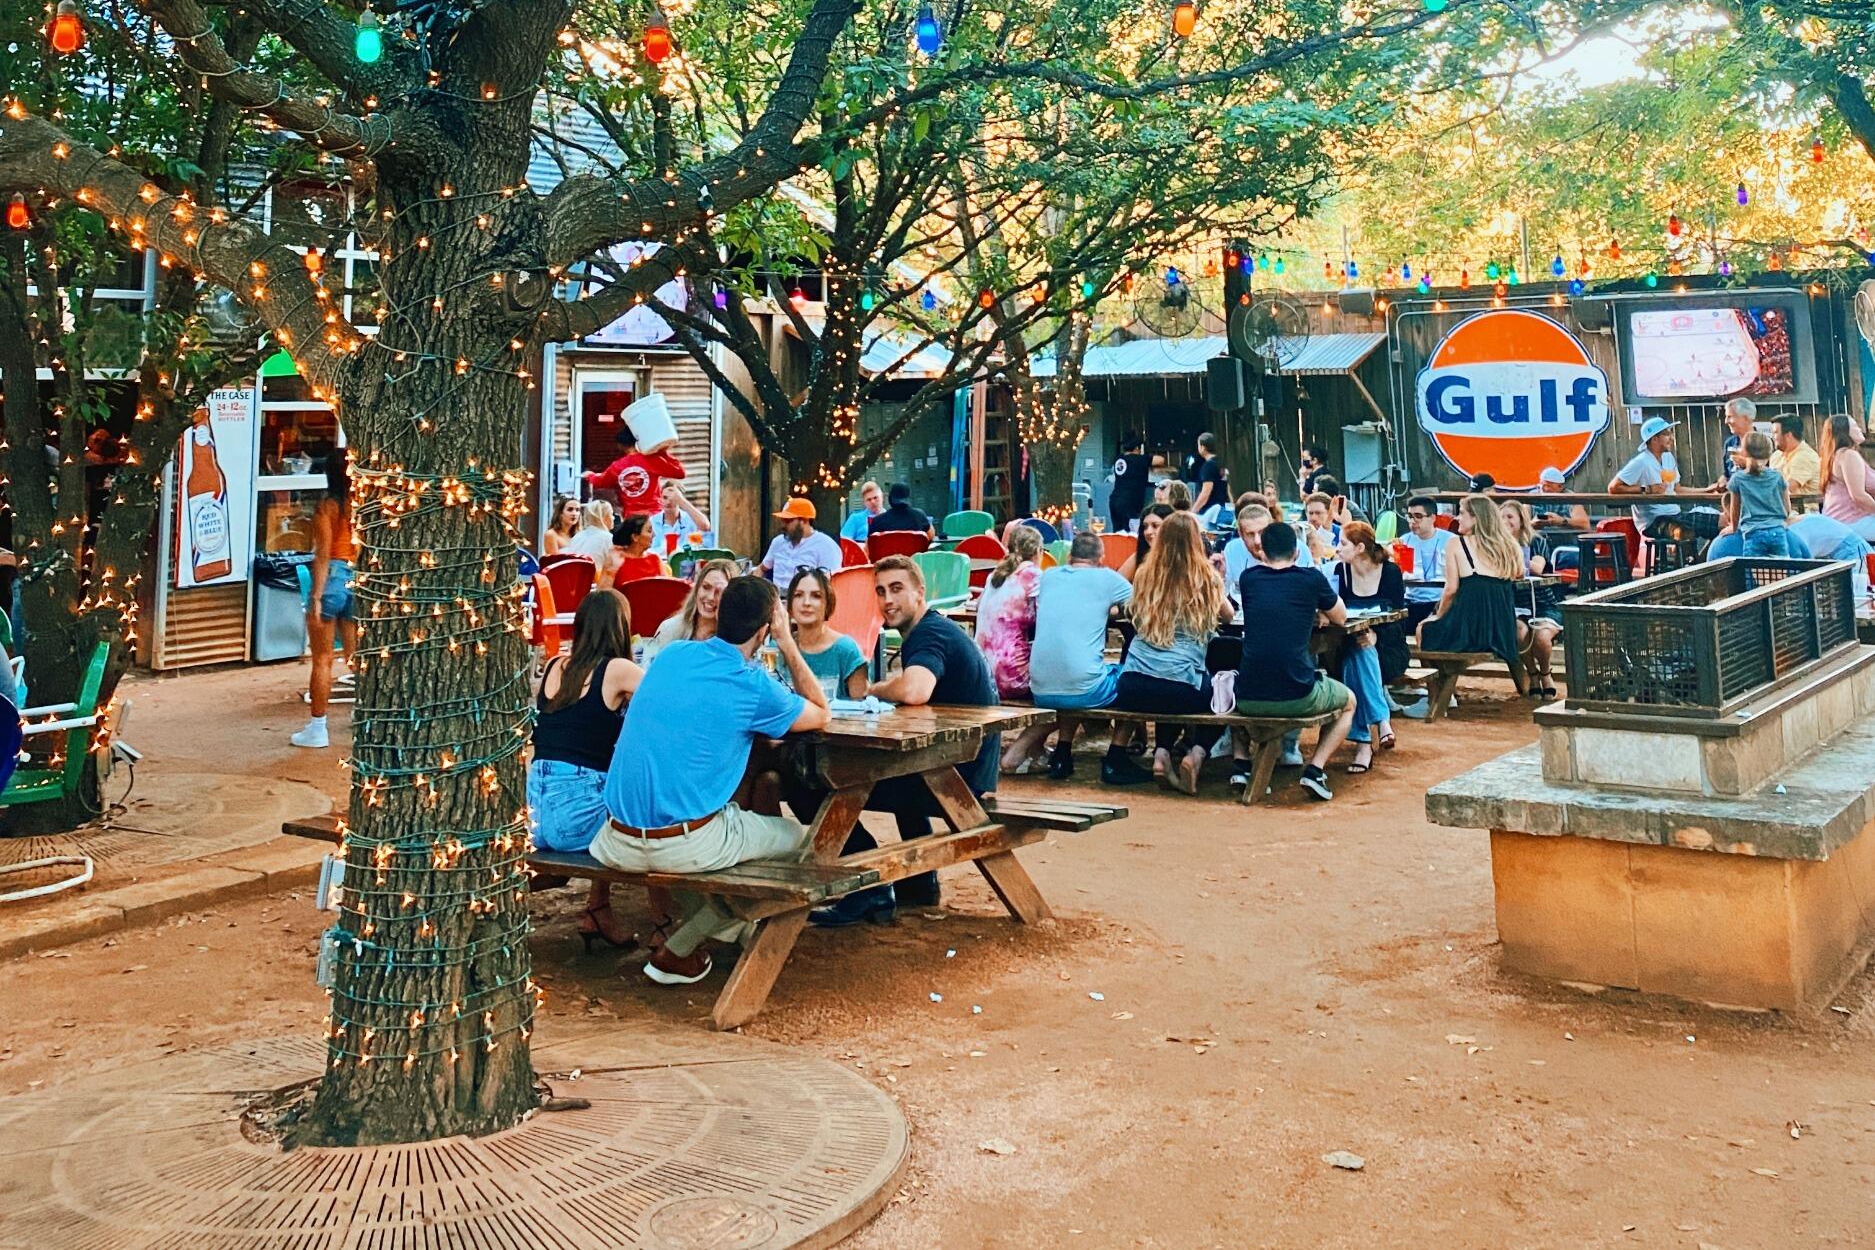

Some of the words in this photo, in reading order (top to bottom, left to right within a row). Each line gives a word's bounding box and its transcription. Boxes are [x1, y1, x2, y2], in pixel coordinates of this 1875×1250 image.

[211, 391, 227, 400] THE
[228, 391, 250, 400] CASE
[1425, 375, 1598, 424] Gulf
[202, 512, 217, 520] RED
[198, 519, 221, 528] WHITE
